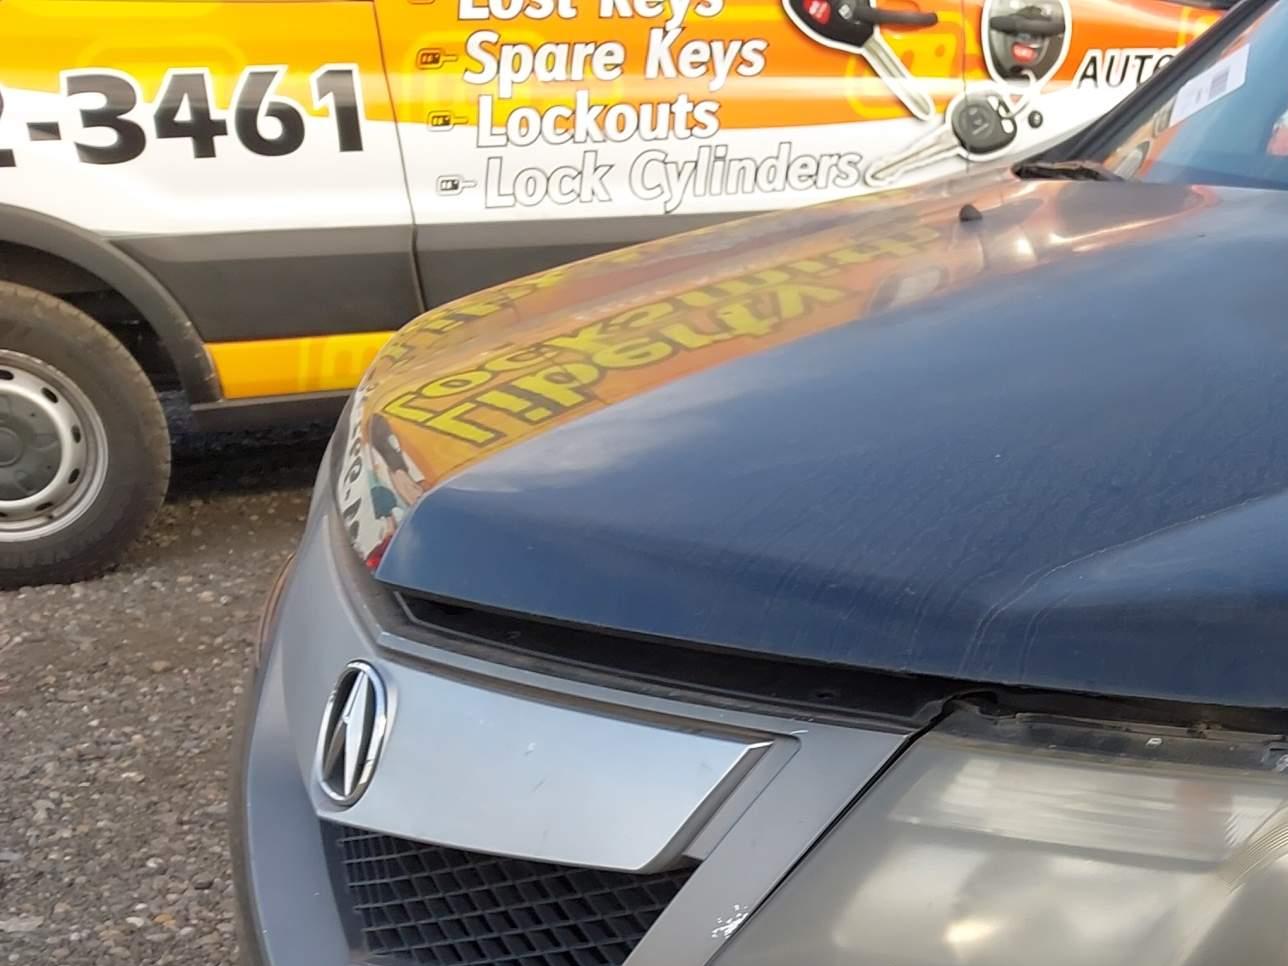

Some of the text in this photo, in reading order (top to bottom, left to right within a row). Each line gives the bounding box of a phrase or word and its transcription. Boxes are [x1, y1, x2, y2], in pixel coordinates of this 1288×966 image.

[463, 27, 769, 99] Spare Keys
[0, 69, 365, 168] -3461
[476, 91, 721, 148] Lockouts
[485, 142, 865, 214] Lock Cylinders
